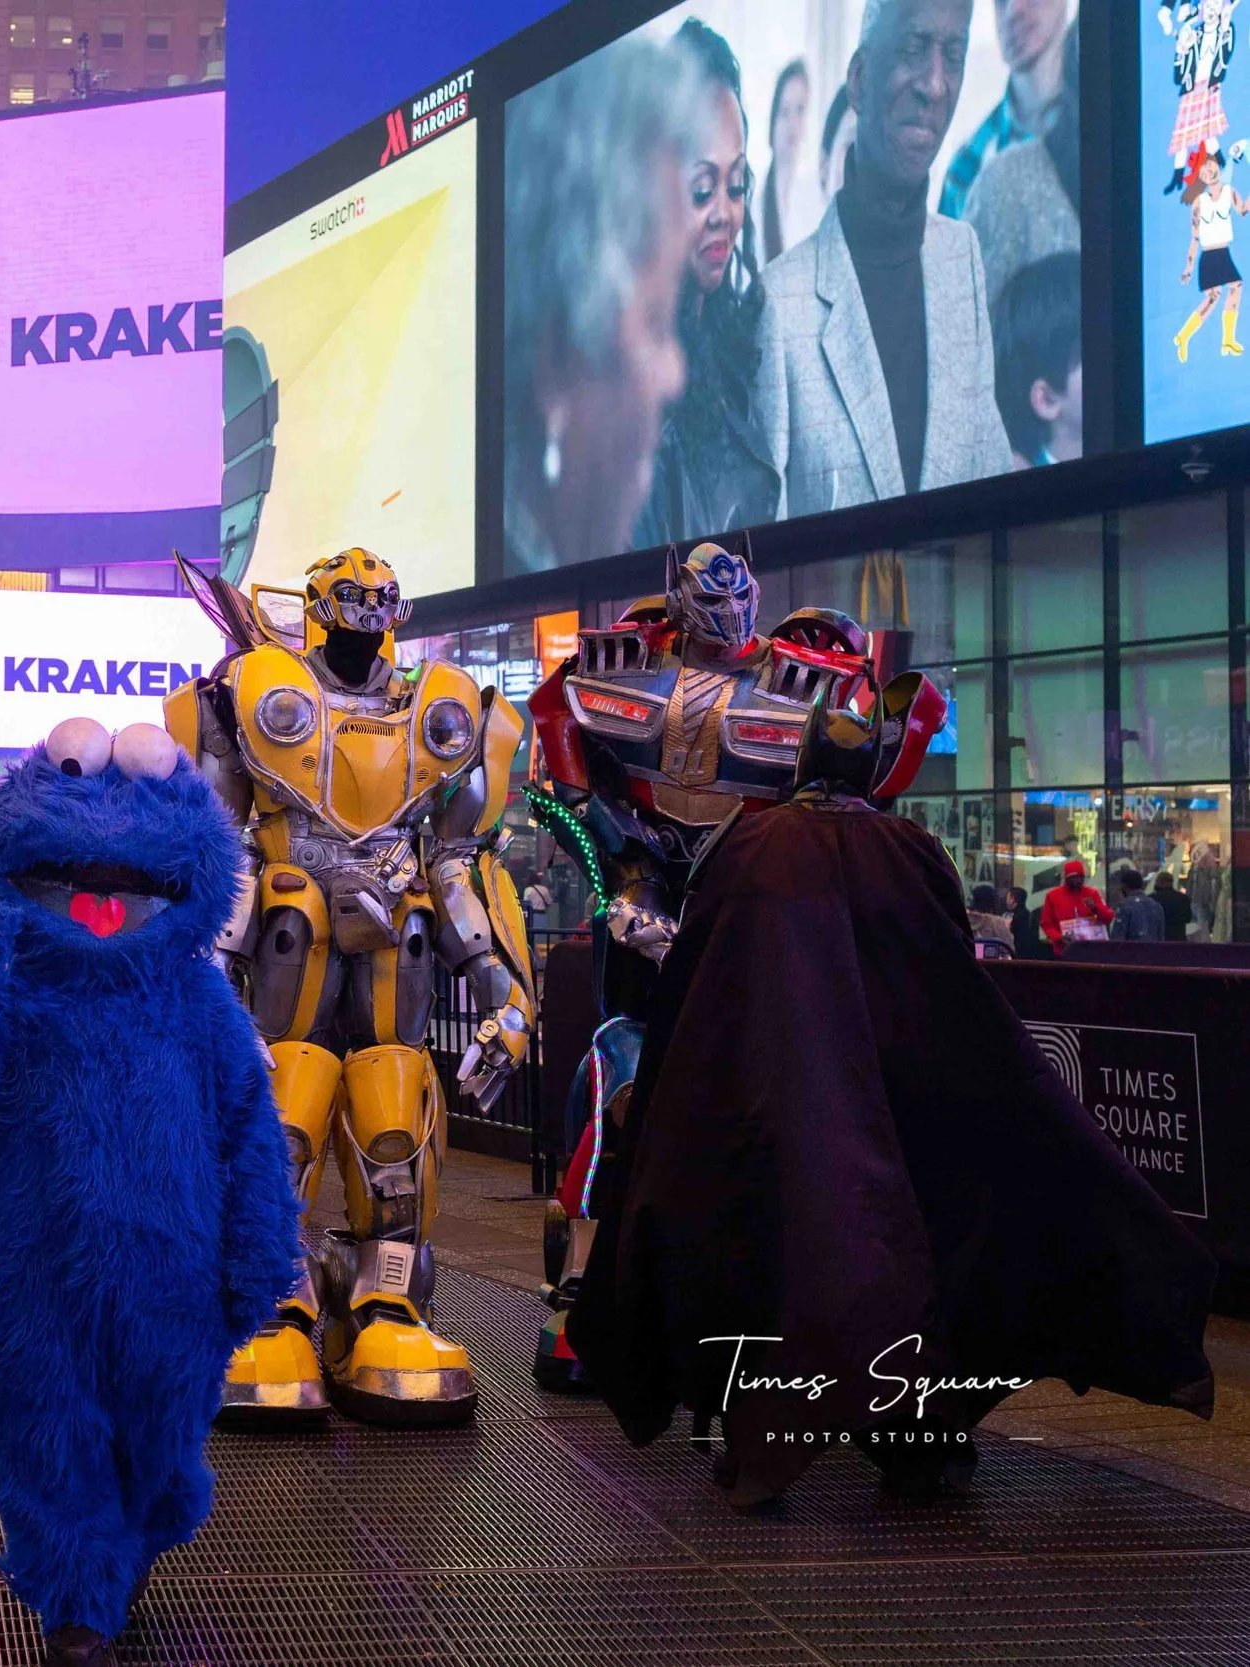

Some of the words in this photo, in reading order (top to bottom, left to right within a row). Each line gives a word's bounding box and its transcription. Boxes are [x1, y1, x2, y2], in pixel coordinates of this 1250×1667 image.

[412, 70, 474, 119] MARRIOTT
[412, 98, 467, 141] MARQUIS
[310, 200, 357, 240] swatch
[4, 656, 201, 697] KRAKEN
[1099, 1067, 1177, 1101] TIMES
[1094, 1103, 1189, 1142] SQUARE
